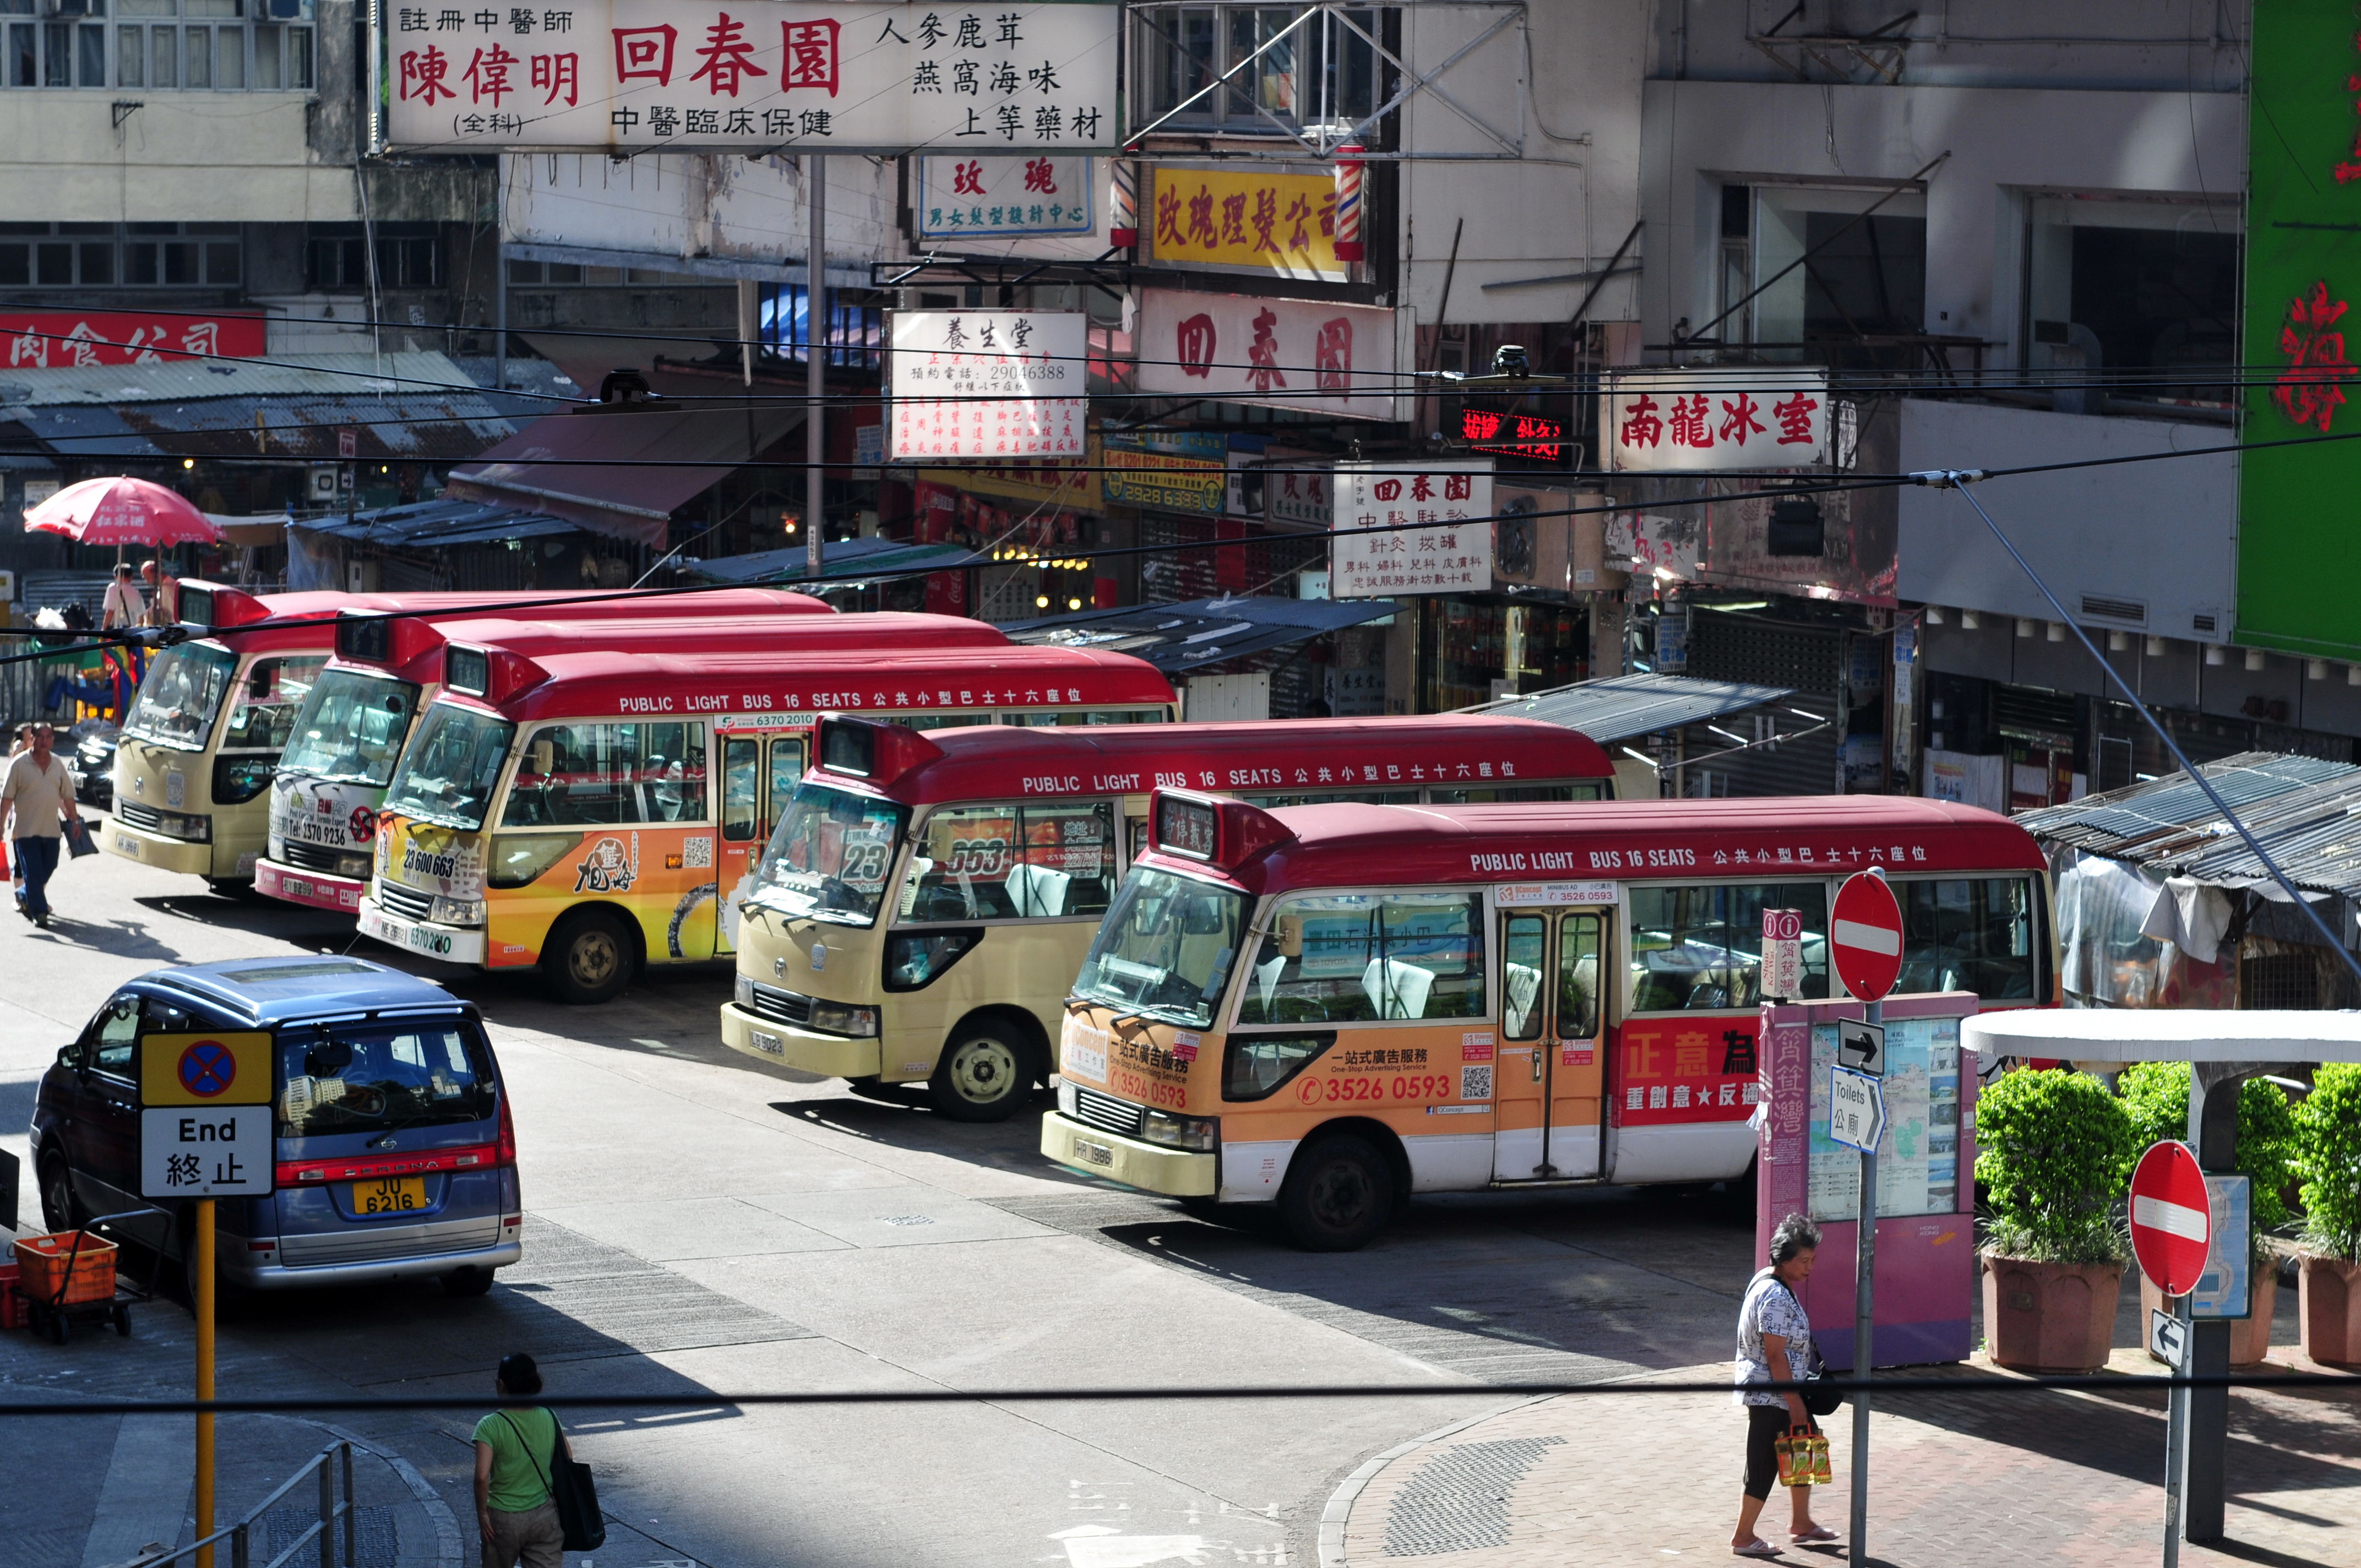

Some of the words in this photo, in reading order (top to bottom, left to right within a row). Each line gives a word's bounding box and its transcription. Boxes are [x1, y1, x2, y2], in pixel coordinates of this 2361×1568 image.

[399, 8, 574, 34] 註冊中醫師
[877, 13, 1024, 50] 人參鹿茸
[612, 12, 841, 98] 回春園
[399, 42, 579, 108] 陳偉明
[912, 61, 1062, 95] 燕窩海味
[612, 106, 833, 137] 中醫臨床保健
[955, 106, 1102, 140] 上等藥材
[954, 156, 1057, 194] 玫瑰
[929, 203, 1084, 226] 男女髮型設計中心
[10, 322, 219, 367] 肉食公司
[942, 317, 1033, 350] 養生堂
[1177, 307, 1352, 403] 回春園
[991, 366, 1065, 379] 29046388
[1621, 392, 1818, 448] 南龍冰室
[1374, 475, 1471, 502] 回春園
[620, 697, 673, 711] PUBLIC
[686, 695, 729, 710] LIGHT
[743, 694, 772, 709] BUS
[784, 694, 799, 707] 16
[812, 693, 861, 707] SEATS
[874, 688, 1081, 706] 公共小型巴士十六座位
[757, 716, 784, 725] 6370
[787, 715, 813, 724] 2010
[1023, 776, 1080, 793] PUBLIC
[1094, 774, 1140, 790] LIGHT
[1155, 772, 1187, 787] BUS
[1199, 771, 1216, 786] 16
[1230, 769, 1282, 785] SEATS
[1294, 761, 1515, 783] 公共小型巴士十六座位
[290, 820, 300, 836] Tel:
[303, 823, 321, 842] 2370
[324, 827, 345, 845] 9236
[404, 850, 414, 869] 23
[415, 852, 432, 873] 600
[433, 856, 454, 878] 663
[1471, 853, 1526, 872] PUBLIC
[1531, 852, 1573, 869] LIGHT
[1590, 851, 1622, 868] BUS
[1626, 850, 1643, 867] 16
[1649, 848, 1696, 867] SEATS
[1713, 846, 1927, 864] 公共小型巴士十六座位
[1560, 892, 1585, 901] 3526
[411, 928, 428, 948] 6370
[429, 931, 451, 954] 200
[761, 1035, 783, 1053] 9023
[1111, 1037, 1189, 1074] 一站式廣告服務
[1331, 1048, 1427, 1065] 一站式廣告服務
[1627, 1030, 1756, 1079] 正意為
[1111, 1055, 1131, 1069] One-Stop
[1133, 1062, 1161, 1080] Advertising
[1162, 1071, 1187, 1084] Service
[1774, 1028, 1804, 1134] 筲箕灣
[1121, 1073, 1147, 1099] 3526
[1152, 1082, 1187, 1108] 0593
[1326, 1078, 1383, 1101] 3526
[1392, 1075, 1450, 1099] 0593
[1835, 1082, 1865, 1105] Toilets
[179, 1118, 236, 1142] End
[1835, 1109, 1858, 1136] 公廁
[1077, 1142, 1087, 1157] HR
[167, 1153, 246, 1187] 終止
[345, 1161, 438, 1176] SERENA
[377, 1178, 401, 1196] JU
[367, 1194, 413, 1212] 6216
